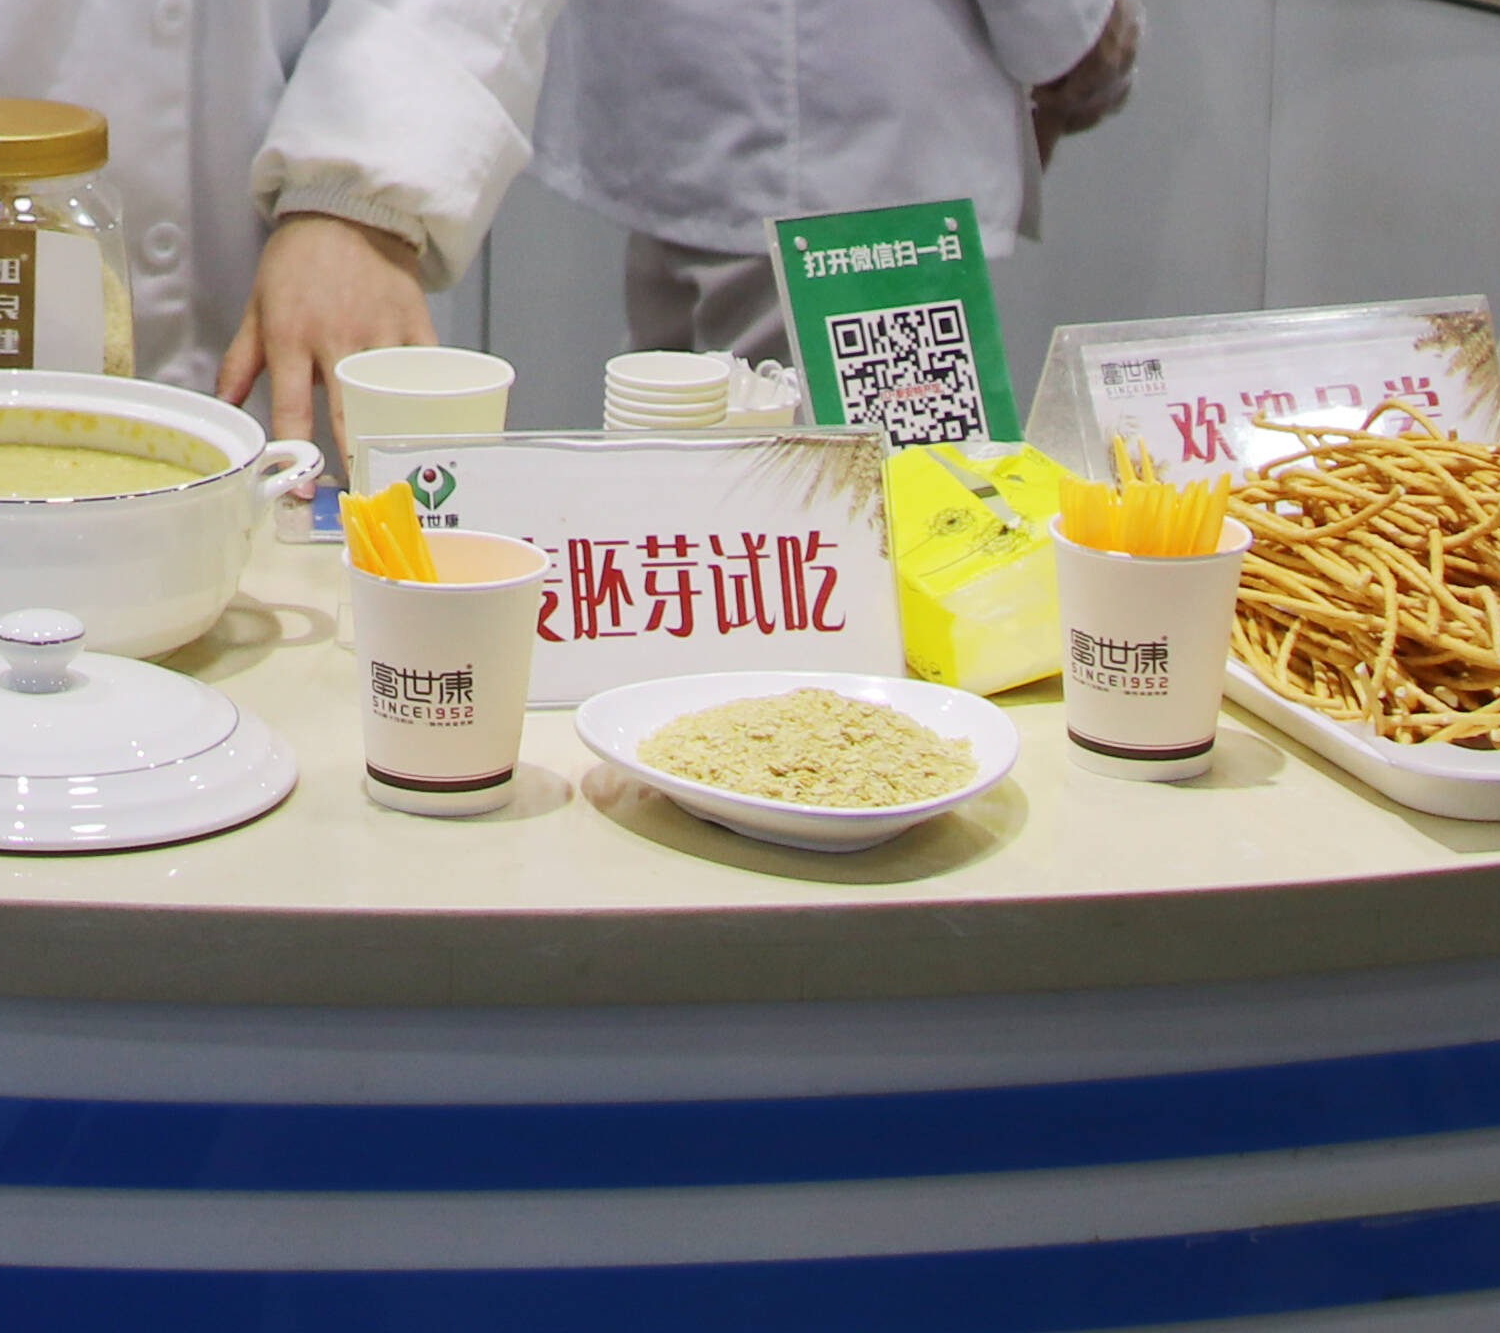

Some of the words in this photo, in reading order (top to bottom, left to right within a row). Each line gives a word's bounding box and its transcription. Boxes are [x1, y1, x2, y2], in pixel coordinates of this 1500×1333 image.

[803, 235, 963, 278] 打开微信扫一扫
[1101, 358, 1166, 385] 富世康
[1070, 628, 1169, 675] 富世康
[371, 660, 474, 705] 富世康
